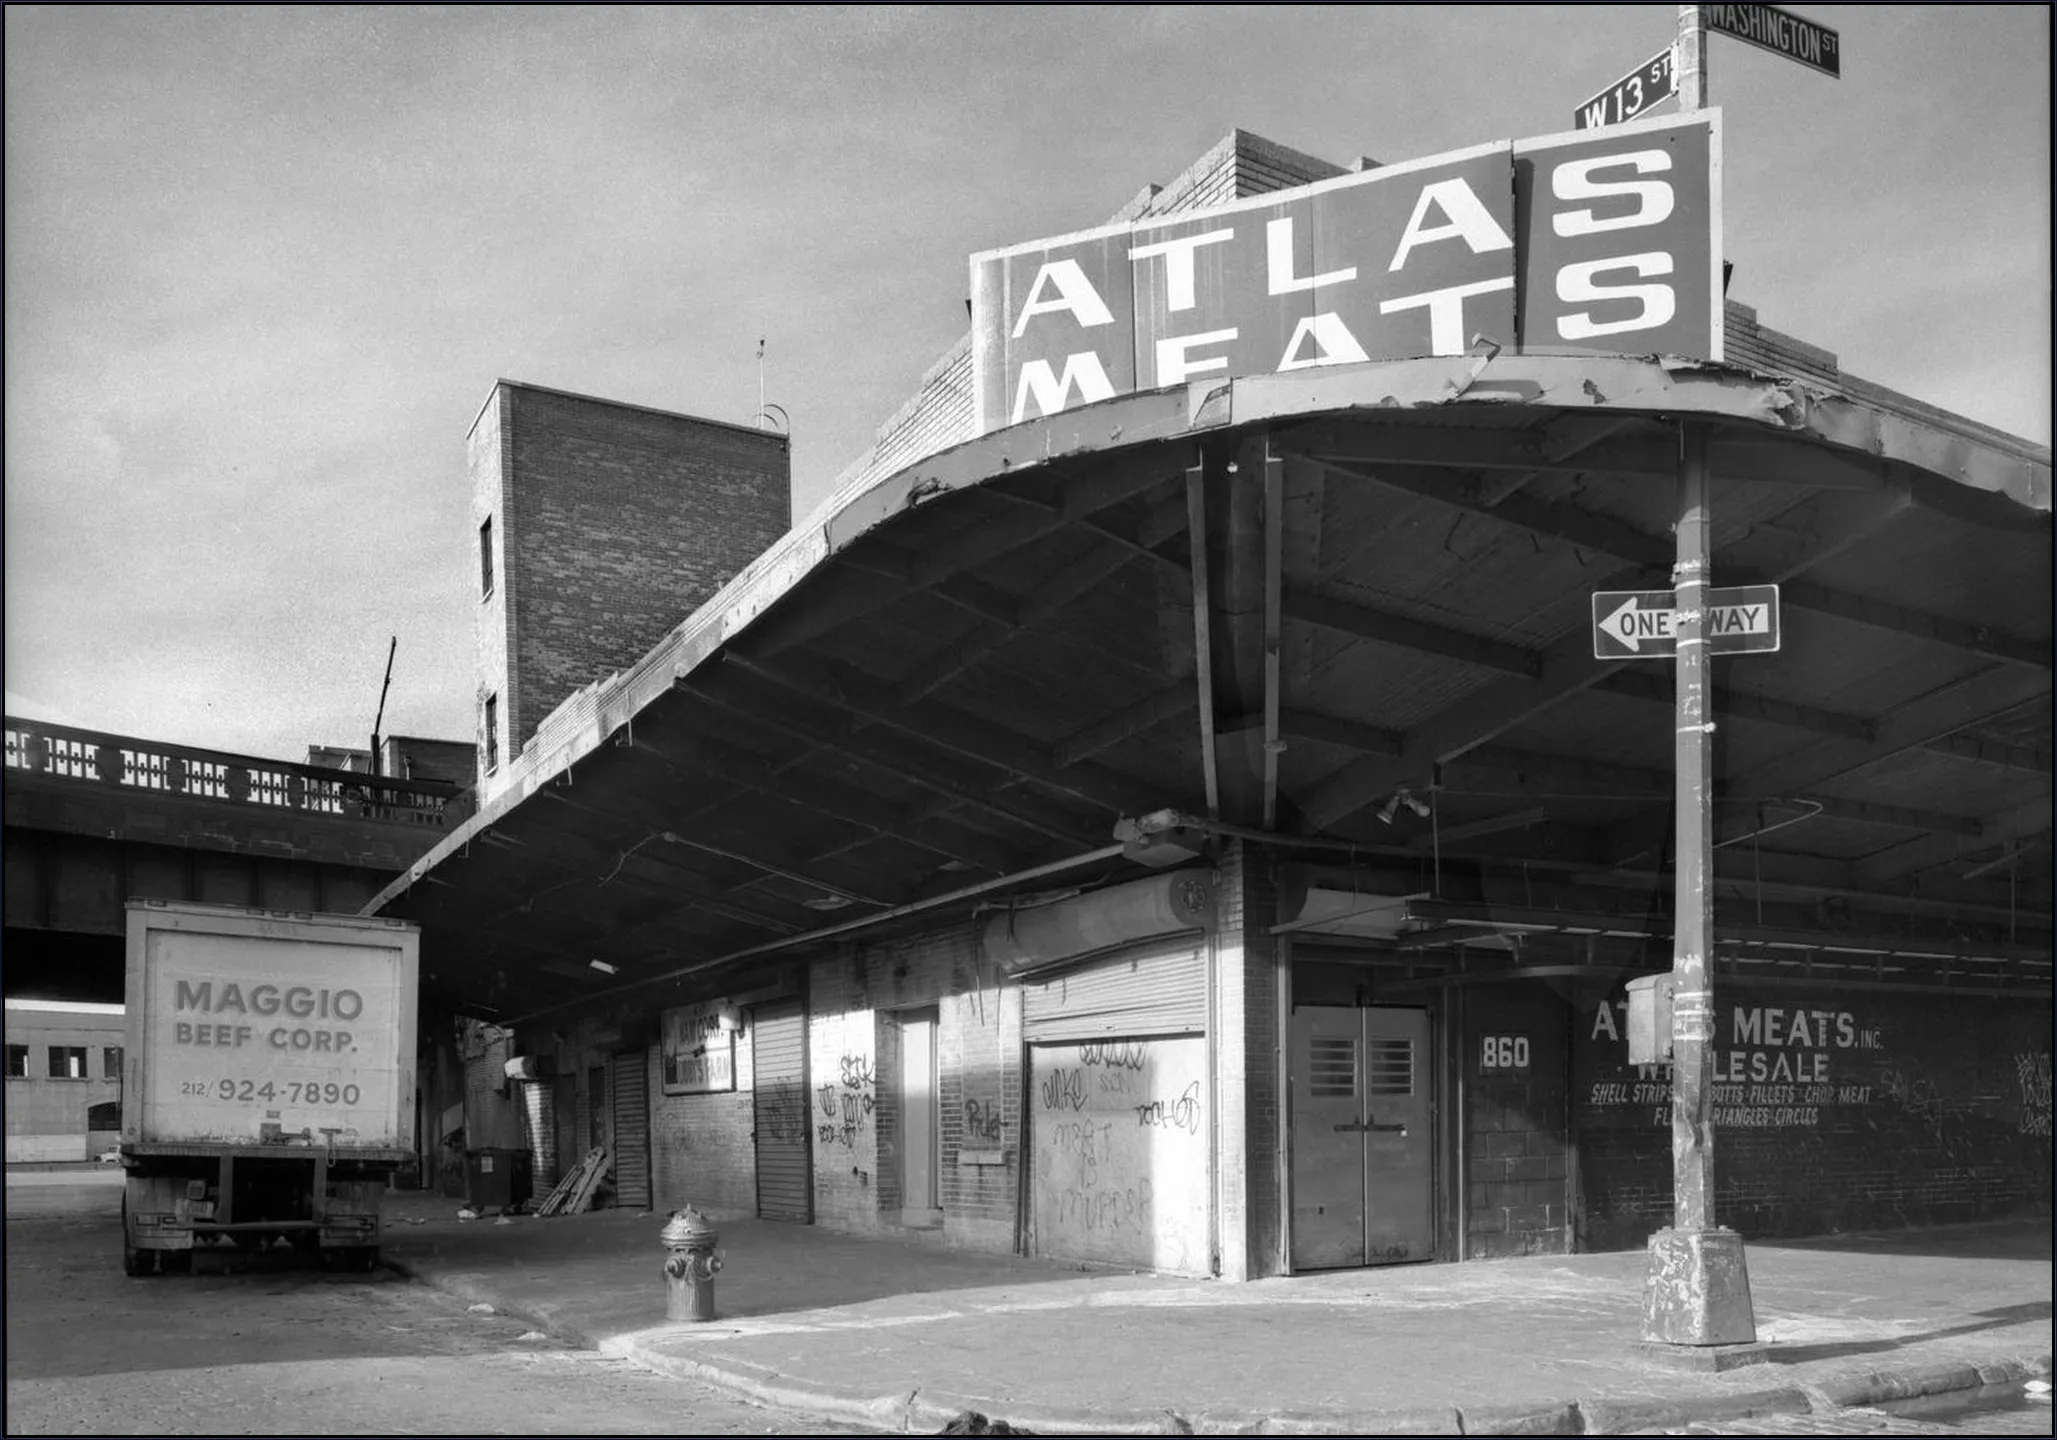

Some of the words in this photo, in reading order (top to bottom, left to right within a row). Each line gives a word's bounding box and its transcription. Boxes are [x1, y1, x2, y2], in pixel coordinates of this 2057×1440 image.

[1822, 33, 1837, 55] ST
[1585, 96, 1607, 129] W
[1614, 76, 1644, 122] 13
[1651, 56, 1670, 83] ST
[1012, 148, 1675, 338] ATLAS
[1011, 250, 1676, 426] MEATS
[1620, 612, 1670, 637] ONE
[175, 980, 363, 1021] MAGGIO
[175, 1022, 252, 1048] BEEF
[267, 1027, 359, 1053] CORP.
[1483, 1036, 1529, 1068] 860
[217, 1078, 361, 1106] 924-7890
[1590, 1082, 1628, 1104] SHELL
[1837, 1086, 1873, 1105] MEAT
[1712, 1107, 1769, 1126] RIANGLES
